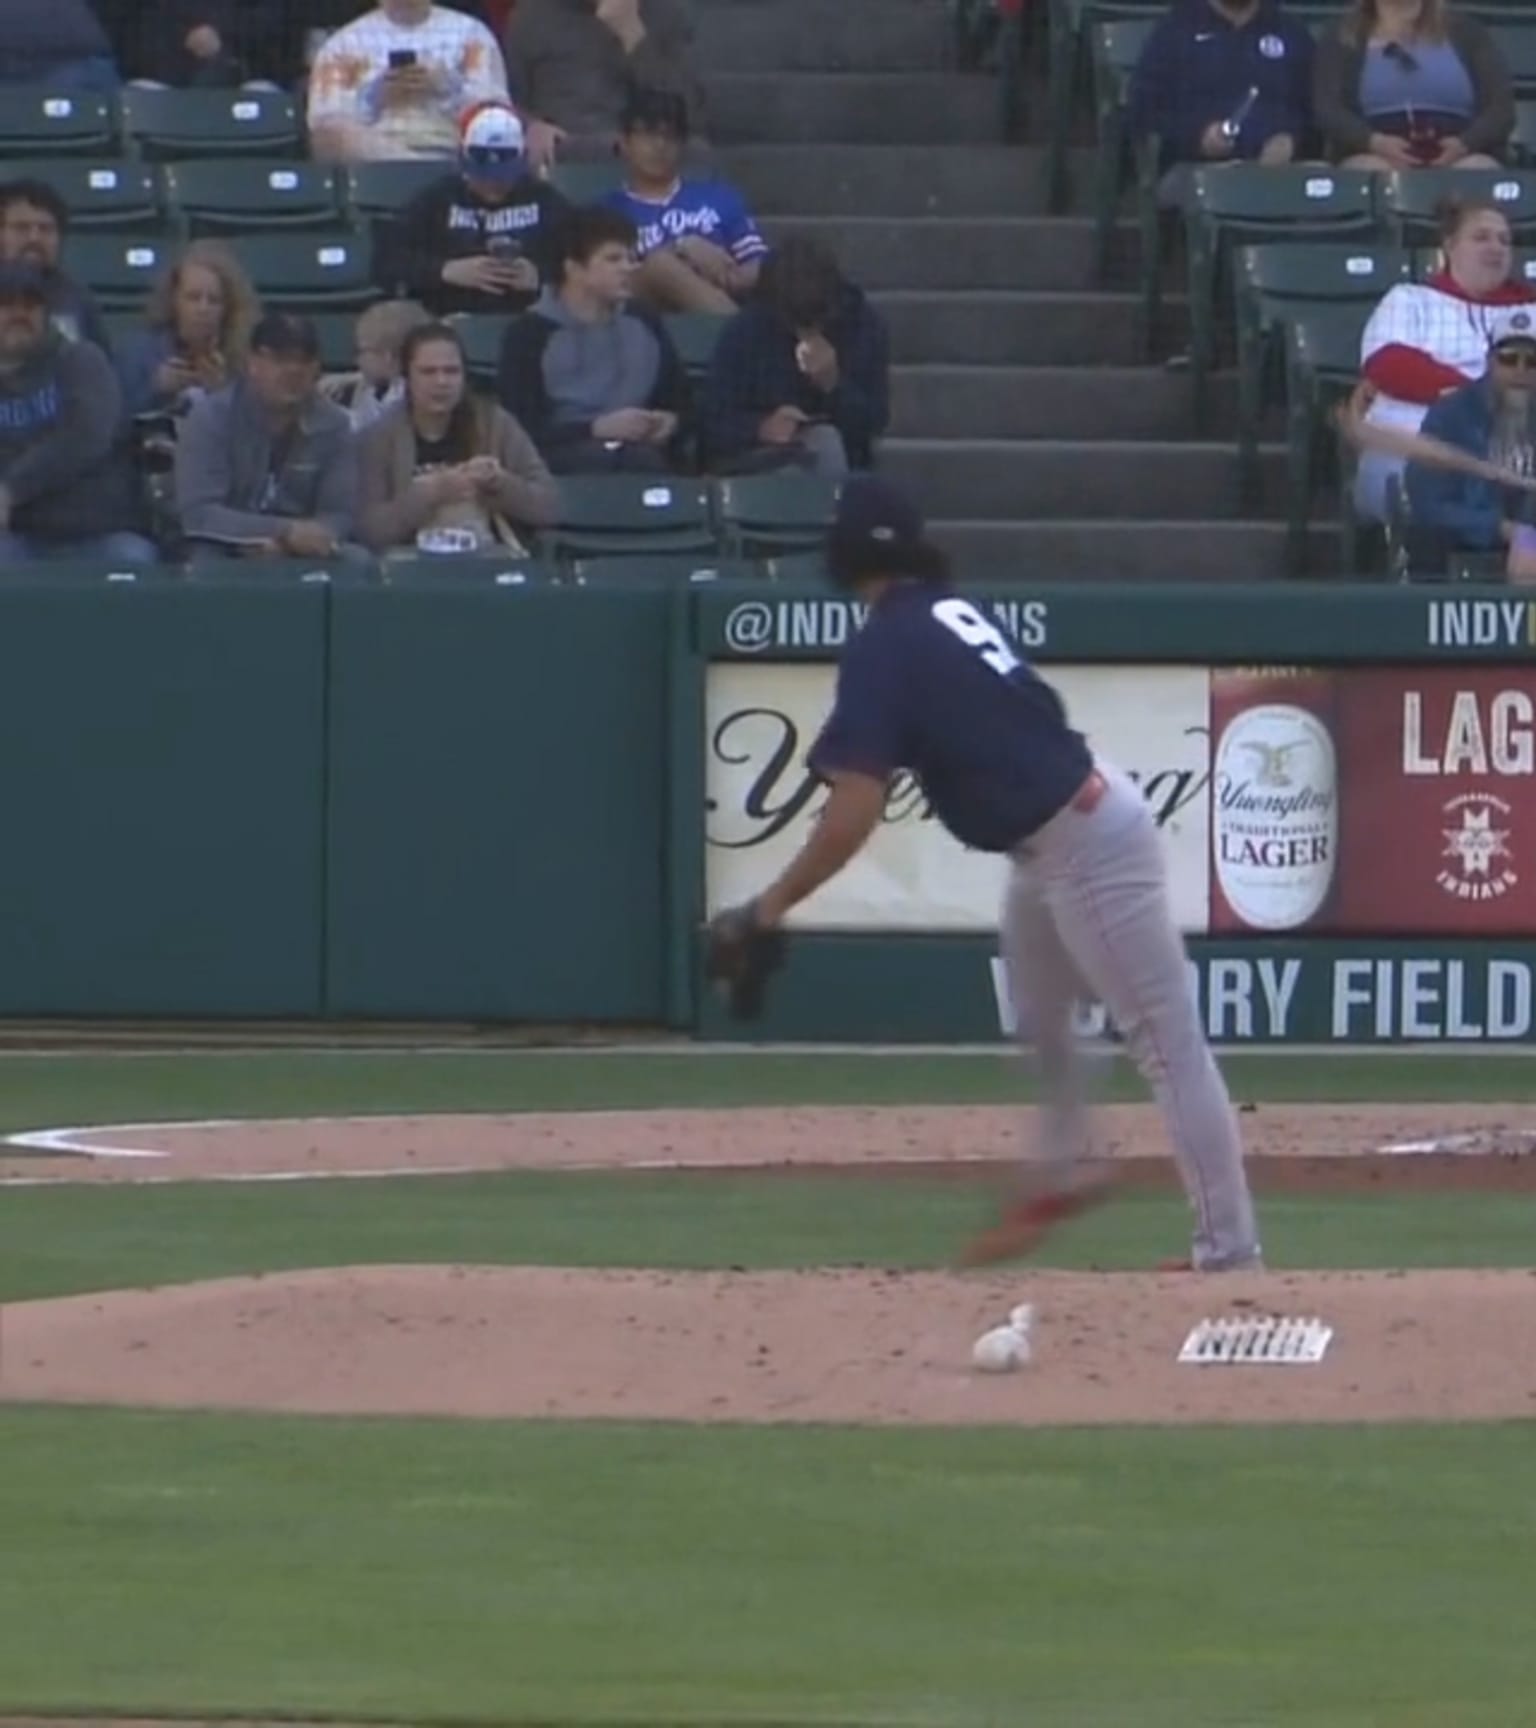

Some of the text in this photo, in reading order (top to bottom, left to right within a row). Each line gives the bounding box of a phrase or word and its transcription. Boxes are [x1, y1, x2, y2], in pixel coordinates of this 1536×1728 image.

[931, 598, 1021, 676] 9
[1216, 774, 1333, 820] Yuengling
[1220, 832, 1328, 868] LAGER
[1435, 868, 1518, 900] INDIANS
[1332, 958, 1532, 1039] FIELD
